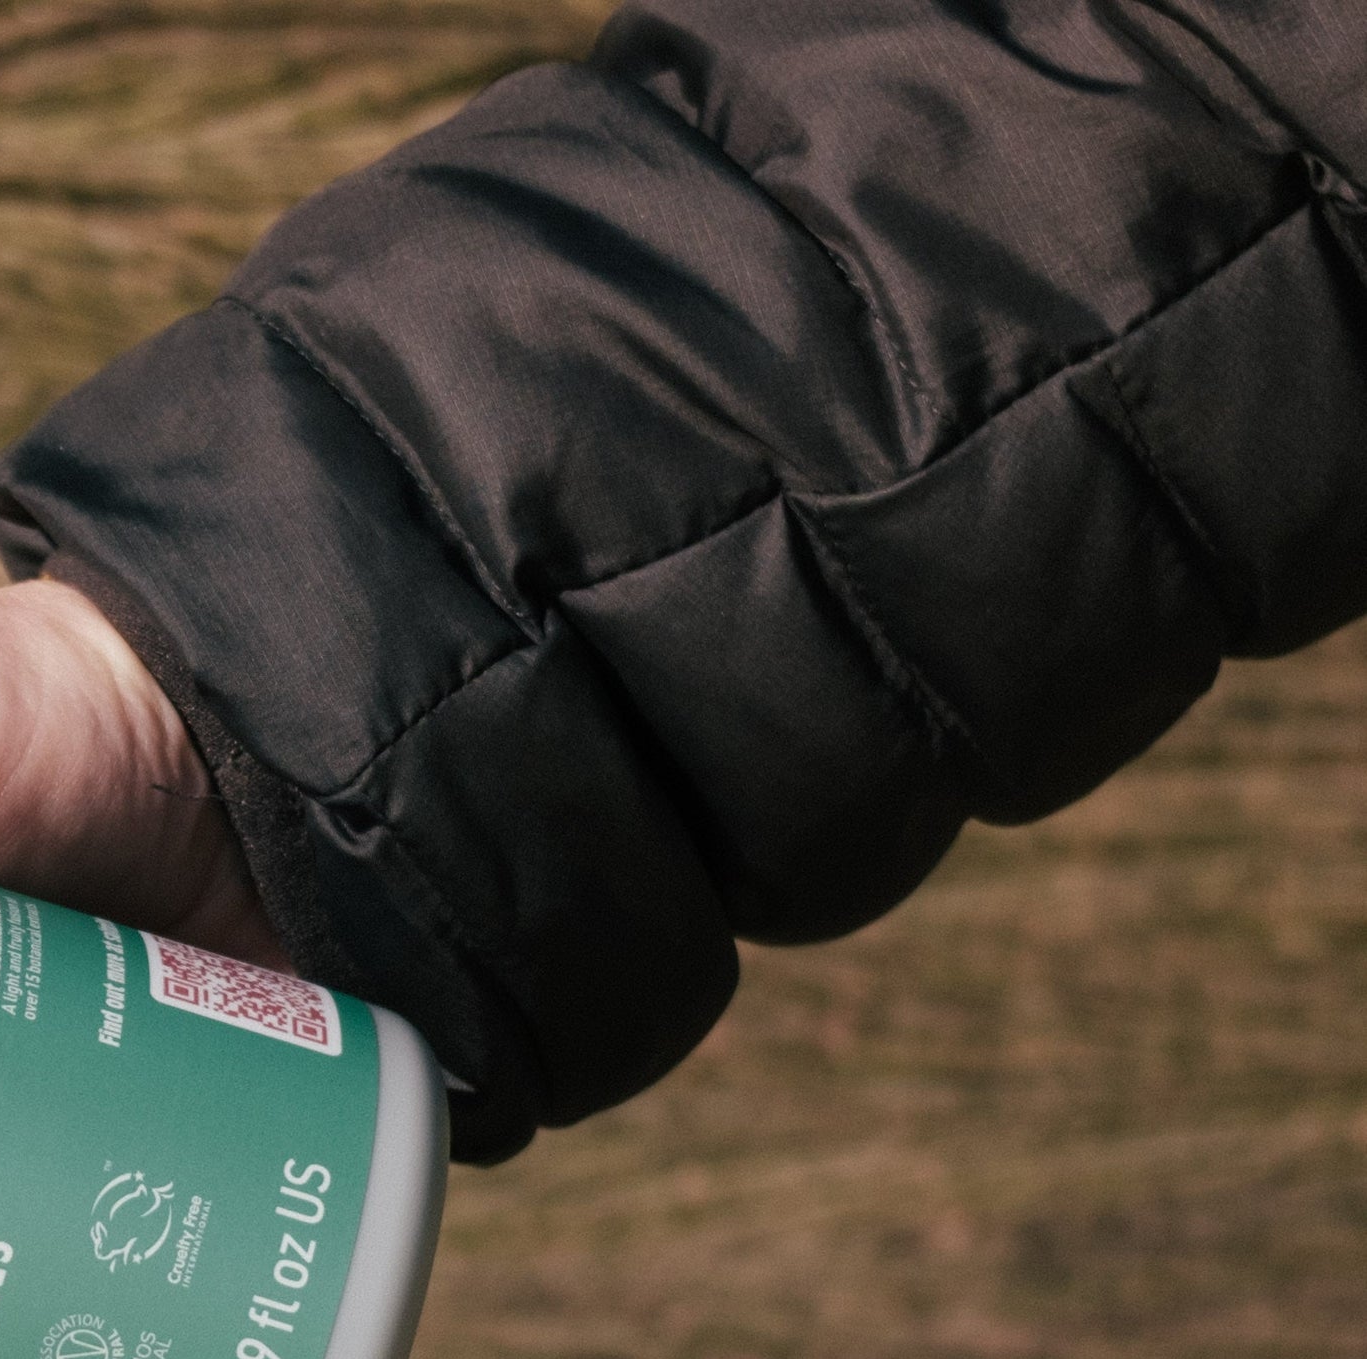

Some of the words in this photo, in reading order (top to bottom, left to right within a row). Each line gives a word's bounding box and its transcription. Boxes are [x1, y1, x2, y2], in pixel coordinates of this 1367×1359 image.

[9, 951, 22, 974] and
[27, 929, 43, 974] botanical
[106, 953, 125, 984] more
[3, 973, 24, 1003] light
[25, 974, 41, 988] 15
[104, 983, 125, 1009] out
[1, 1004, 17, 1016] A
[24, 990, 38, 1021] over
[98, 1009, 124, 1048] Find
[276, 1157, 332, 1226] US
[168, 1230, 193, 1284] Cruelty
[183, 1195, 203, 1228] Free
[182, 1199, 212, 1288] INTERNATIONAL
[273, 1233, 318, 1290] oz
[248, 1294, 301, 1333] fl
